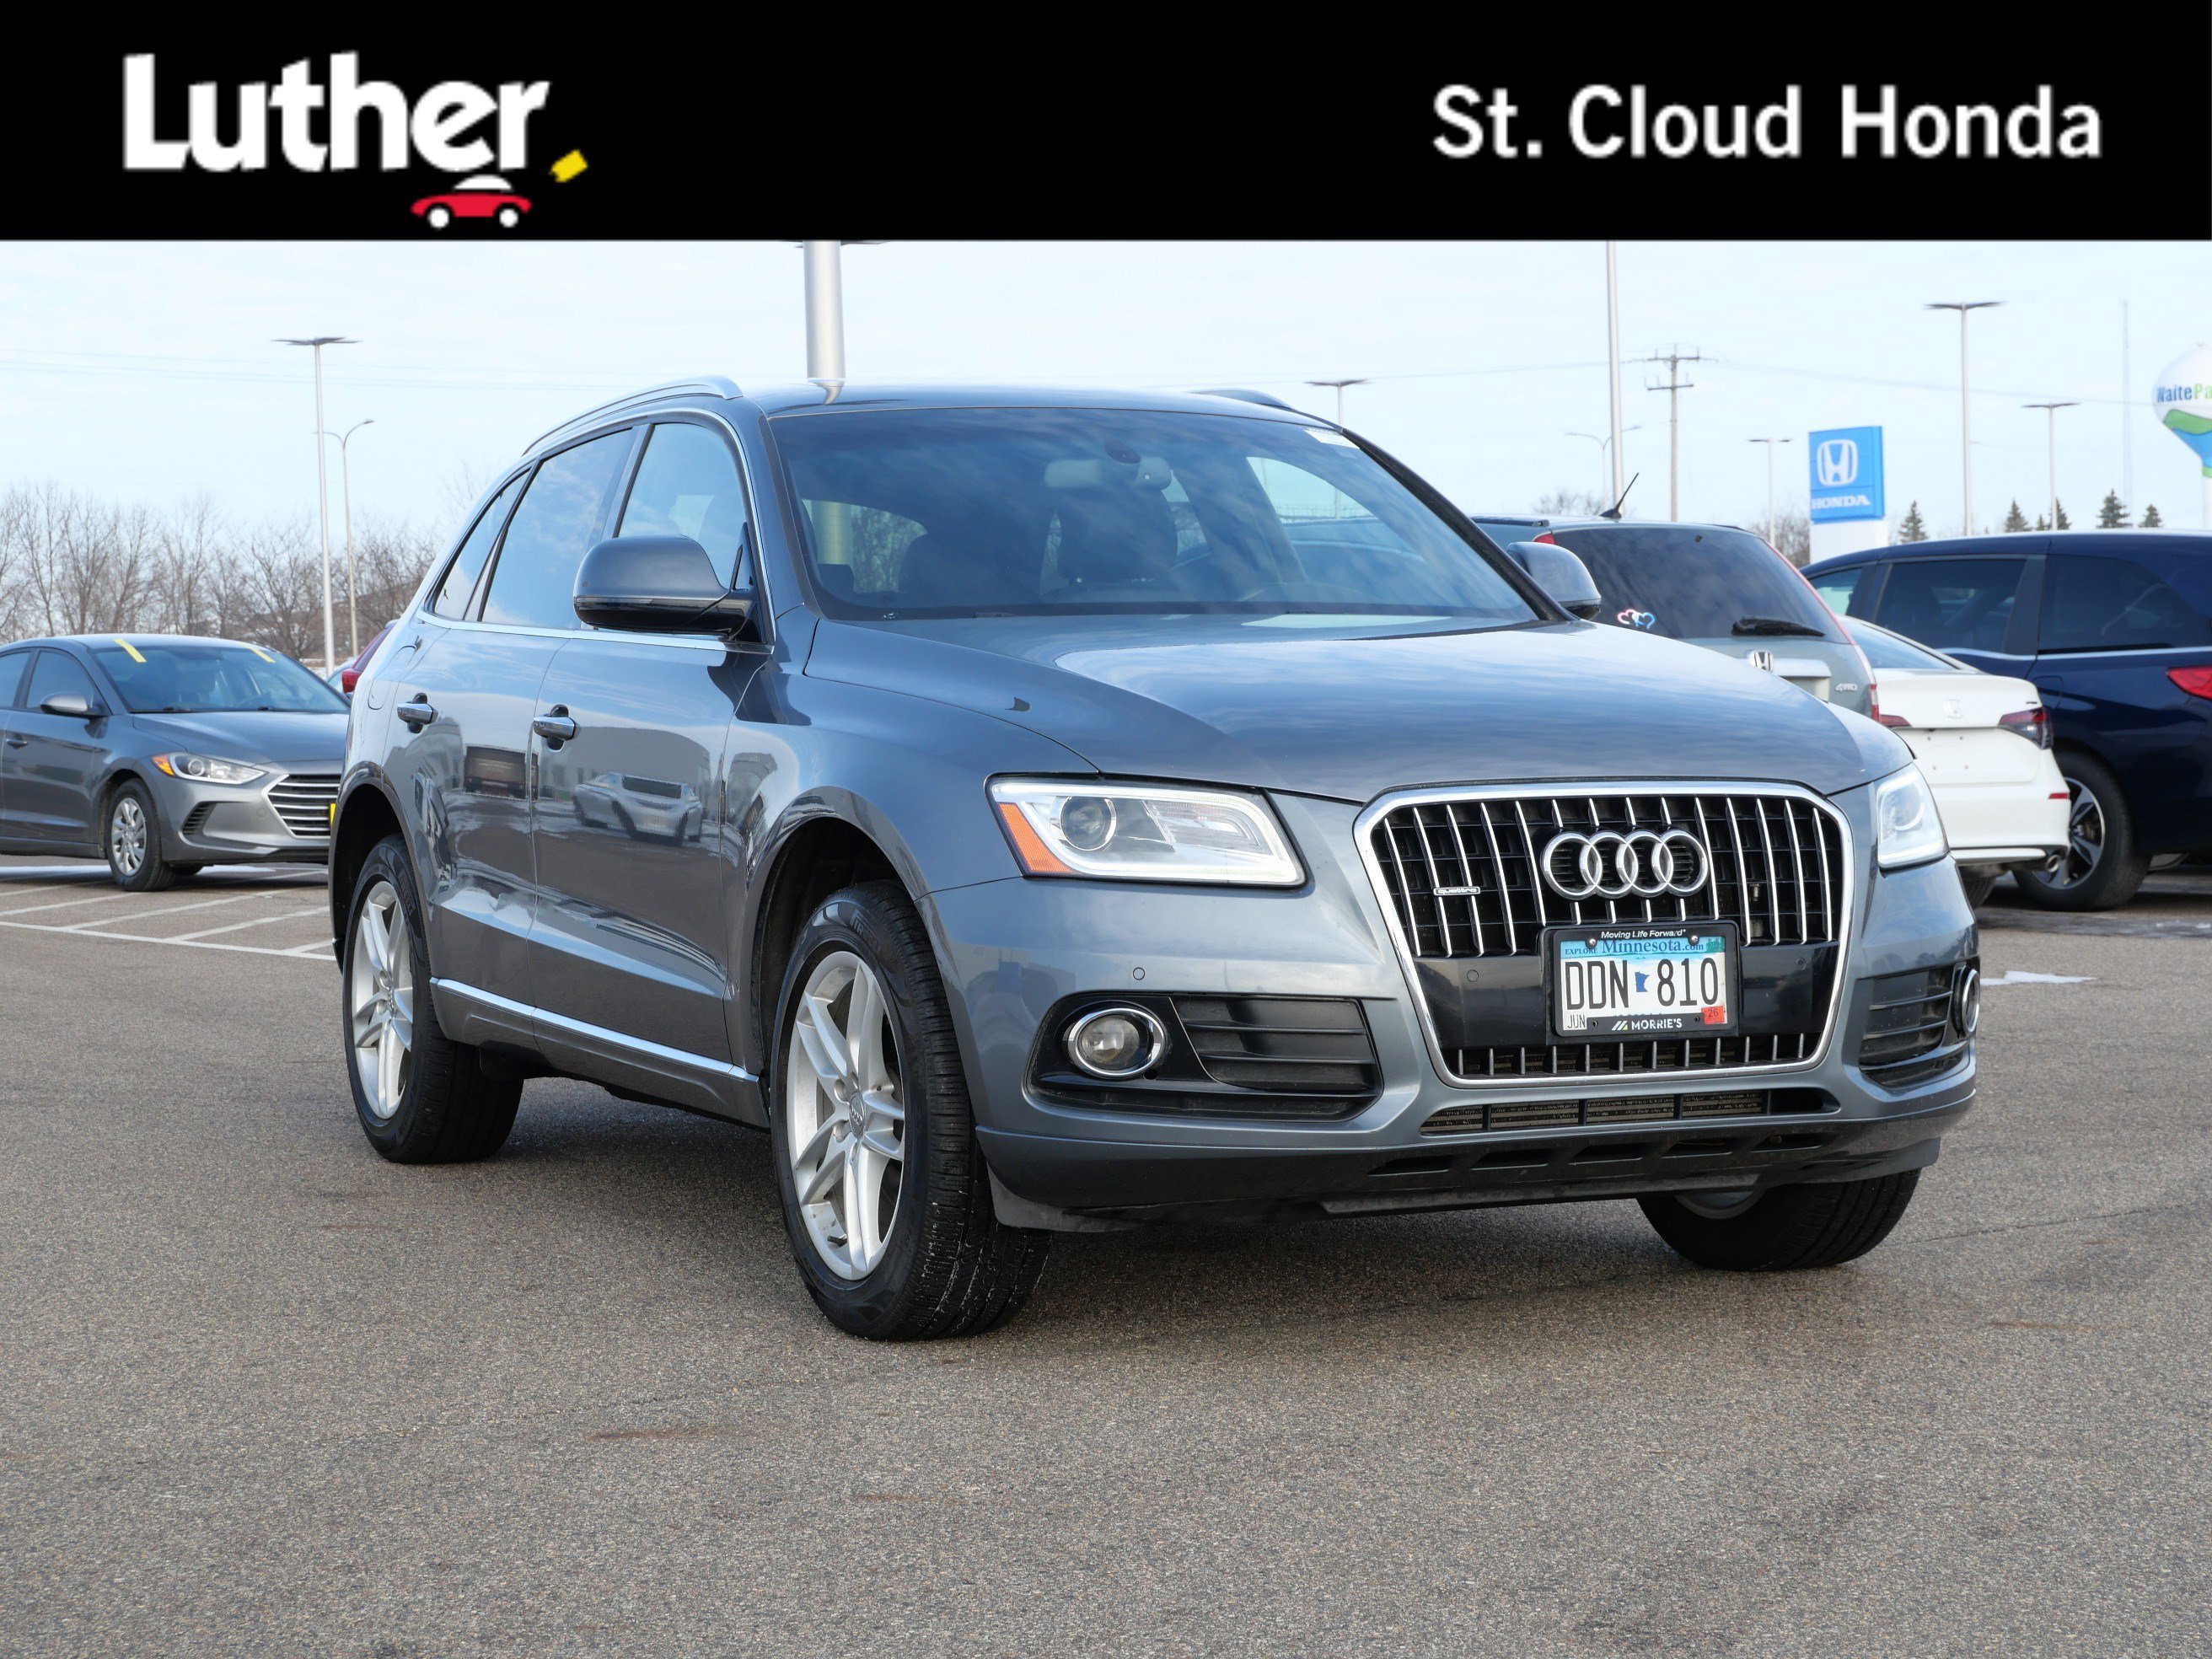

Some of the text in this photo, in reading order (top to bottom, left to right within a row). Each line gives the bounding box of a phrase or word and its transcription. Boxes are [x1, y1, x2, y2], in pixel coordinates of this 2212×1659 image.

[1812, 494, 1871, 510] HONDA
[1601, 931, 1631, 939] Moving
[1632, 930, 1648, 938] Life
[1565, 957, 1719, 1010] DDN 810
[1707, 1007, 1719, 1017] 26
[1567, 1014, 1586, 1028] JUN
[1631, 1017, 1683, 1030] MORRIE'S
